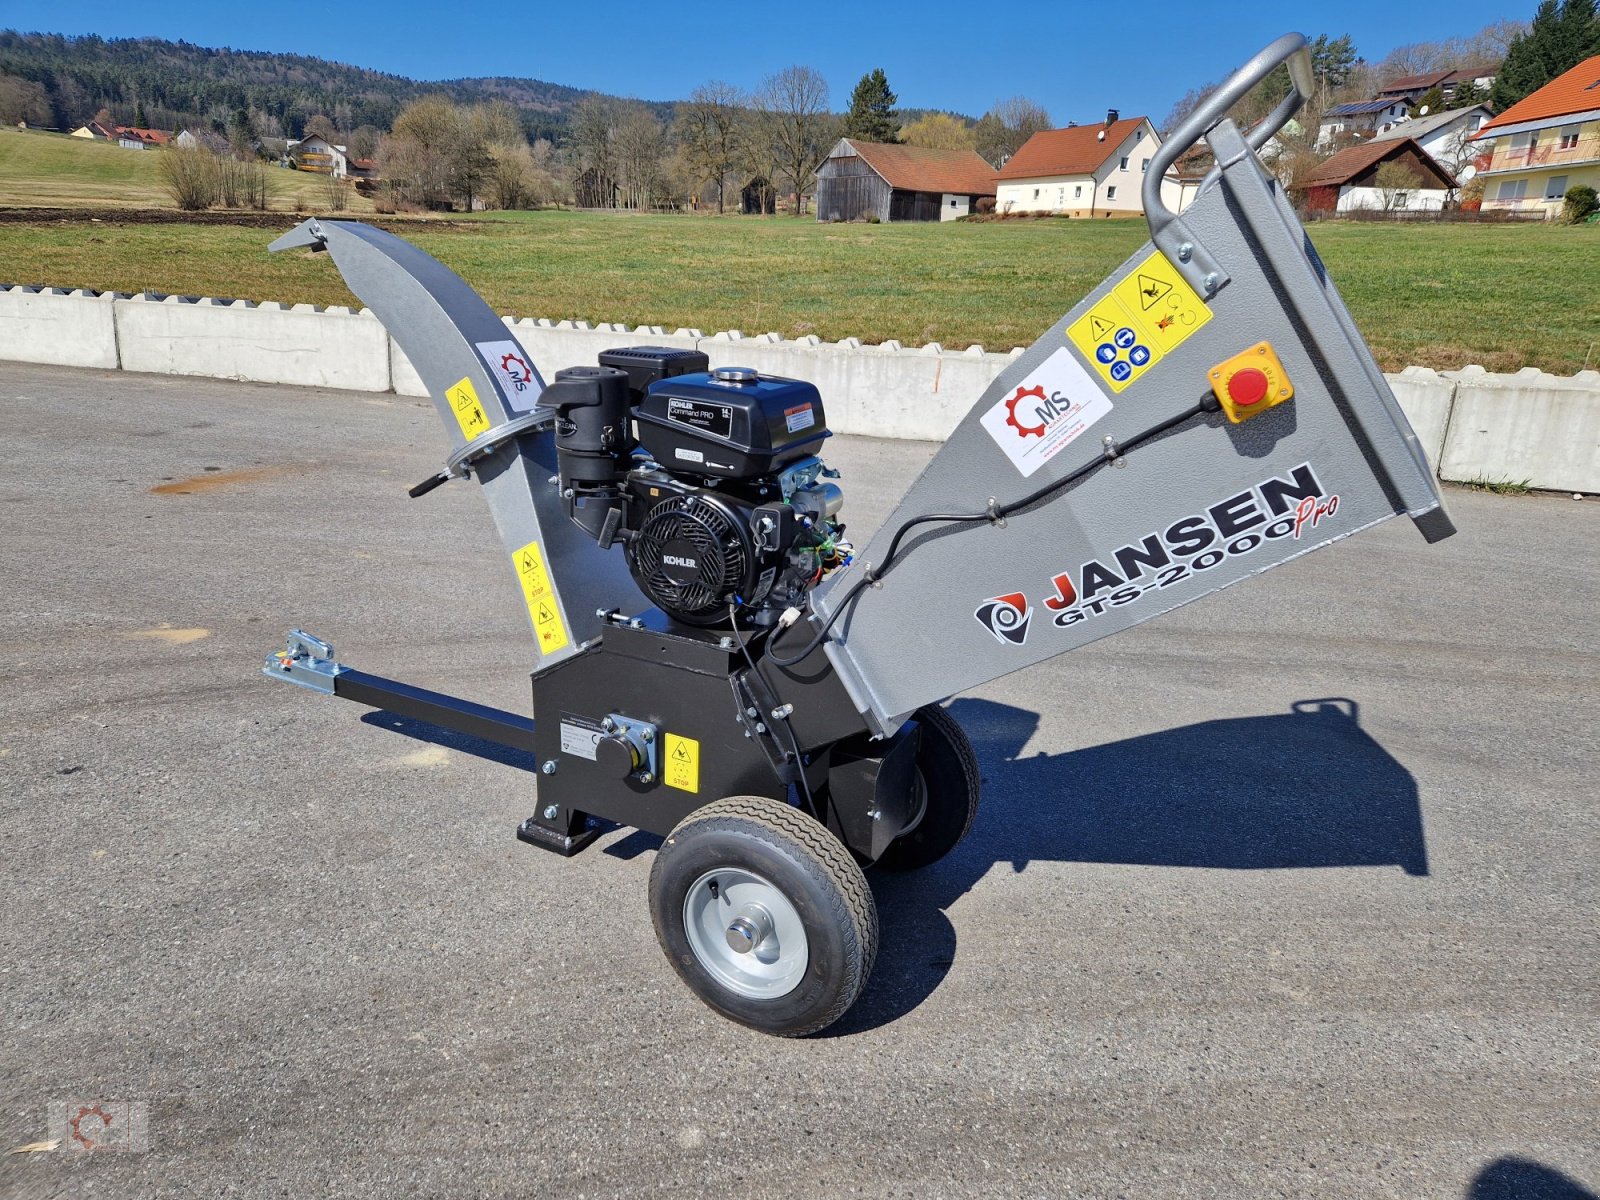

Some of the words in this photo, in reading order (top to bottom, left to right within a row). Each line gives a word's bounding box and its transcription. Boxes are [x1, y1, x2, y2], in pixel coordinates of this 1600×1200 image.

[670, 400, 693, 410] KOHLER
[670, 406, 700, 417] Command
[700, 410, 714, 420] PRO
[1045, 463, 1325, 611] JANSEN
[663, 554, 696, 569] KOHLER
[1054, 516, 1297, 628] GTS-2000
[1293, 495, 1339, 539] Pro
[531, 586, 544, 598] STOP
[673, 777, 690, 787] STOP
